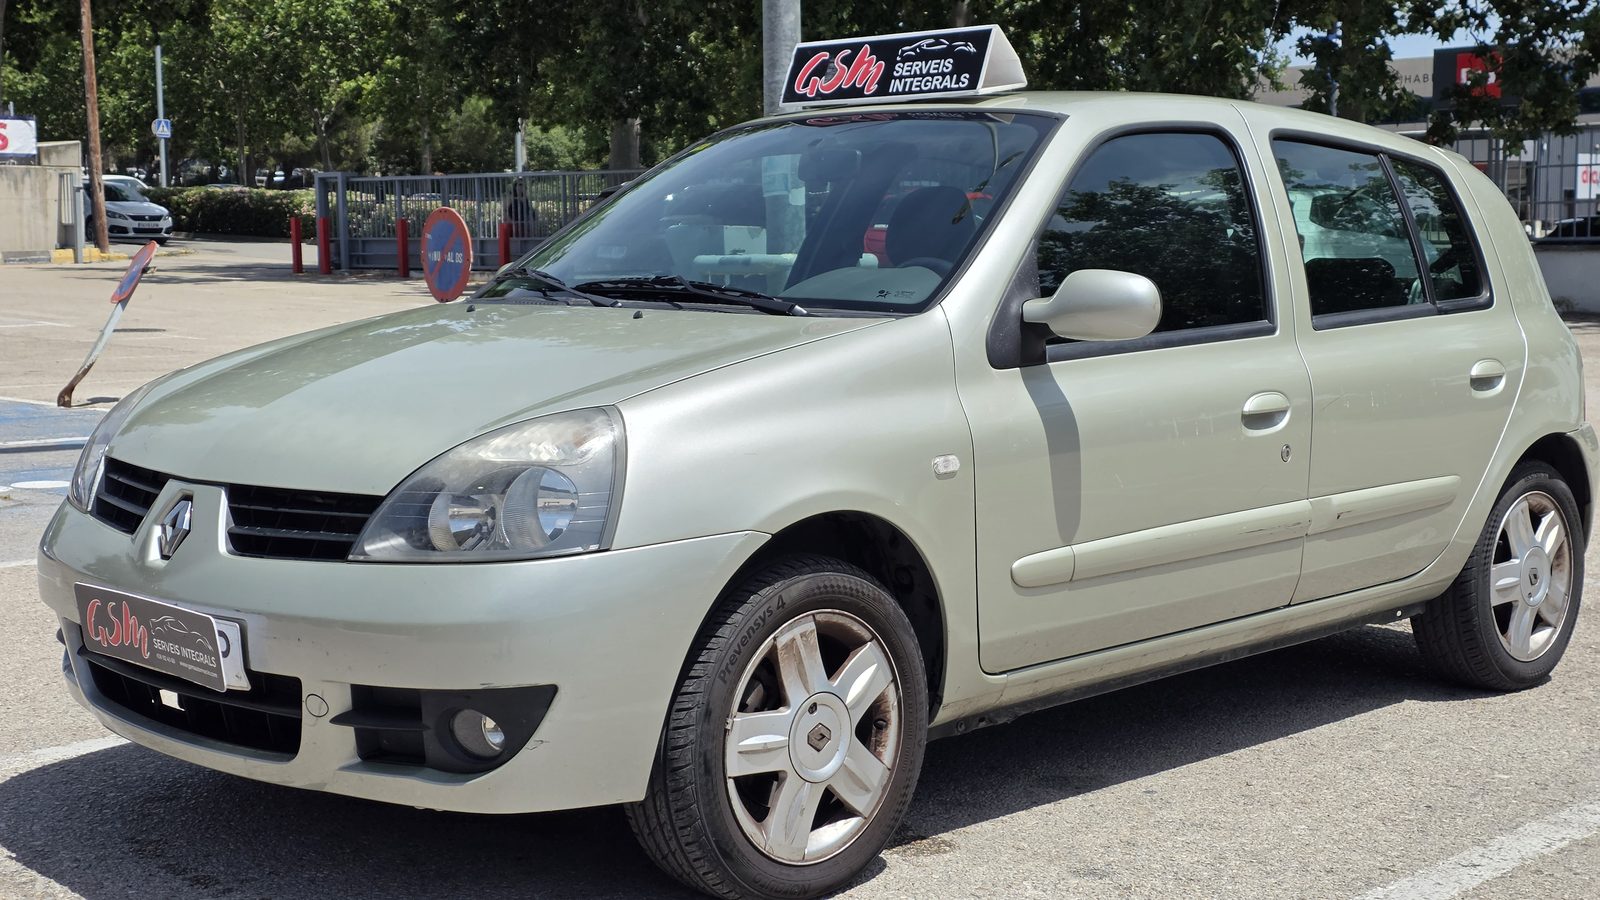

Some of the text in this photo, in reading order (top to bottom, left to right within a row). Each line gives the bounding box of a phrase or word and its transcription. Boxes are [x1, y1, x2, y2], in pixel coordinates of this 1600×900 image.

[893, 58, 953, 77] SERVEIS
[889, 73, 969, 93] INTEGRALS
[718, 594, 786, 685] Prevensys 4
[152, 638, 180, 655] SERVEIS
[180, 646, 217, 668] INTEGRALS
